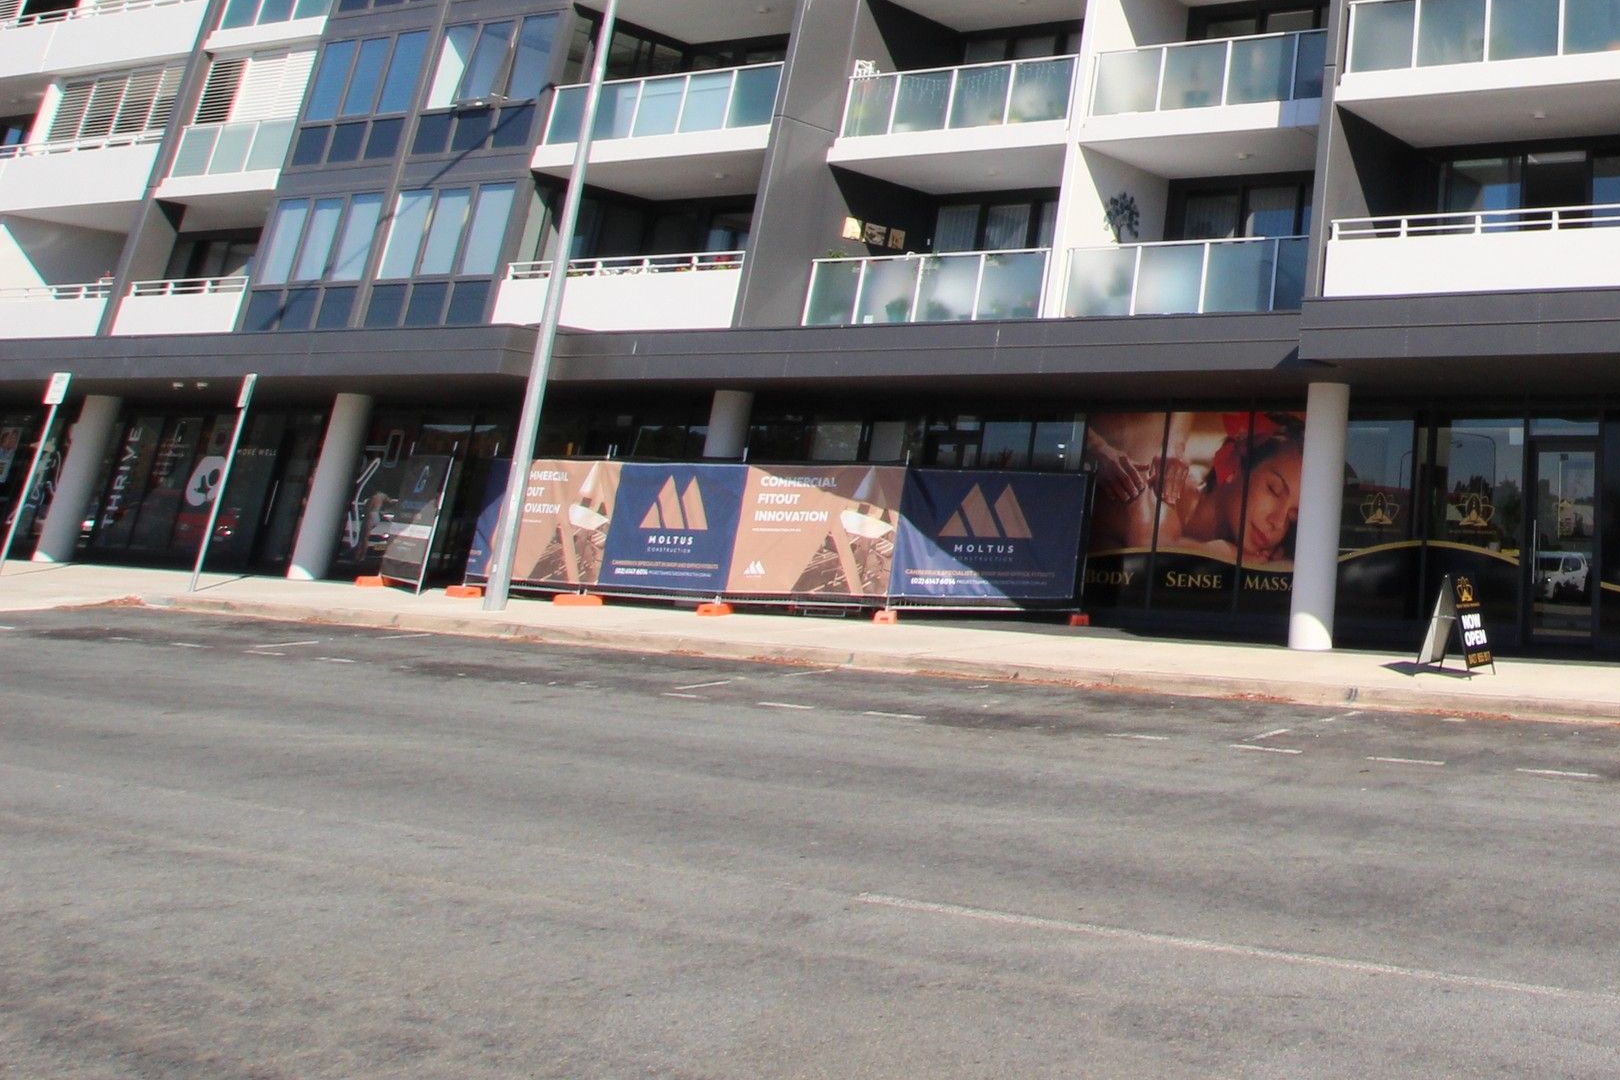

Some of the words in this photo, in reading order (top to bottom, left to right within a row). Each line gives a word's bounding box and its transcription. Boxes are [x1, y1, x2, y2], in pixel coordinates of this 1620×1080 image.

[101, 426, 143, 529] THRIVE
[529, 470, 569, 482] MMERCIAL
[760, 475, 838, 489] COMMERCIAL
[527, 486, 545, 497] OUT
[757, 493, 801, 505] FITOUT
[524, 503, 561, 515] OVATION
[754, 510, 829, 523] INNOVATION
[648, 535, 694, 546] MOLTUS
[954, 544, 1015, 554] MOLTUS
[1085, 571, 1135, 586] BODY
[1165, 571, 1223, 589] SENSE
[1243, 575, 1292, 591] MASS
[1461, 613, 1481, 630] NOW
[1464, 629, 1487, 647] OPEN
